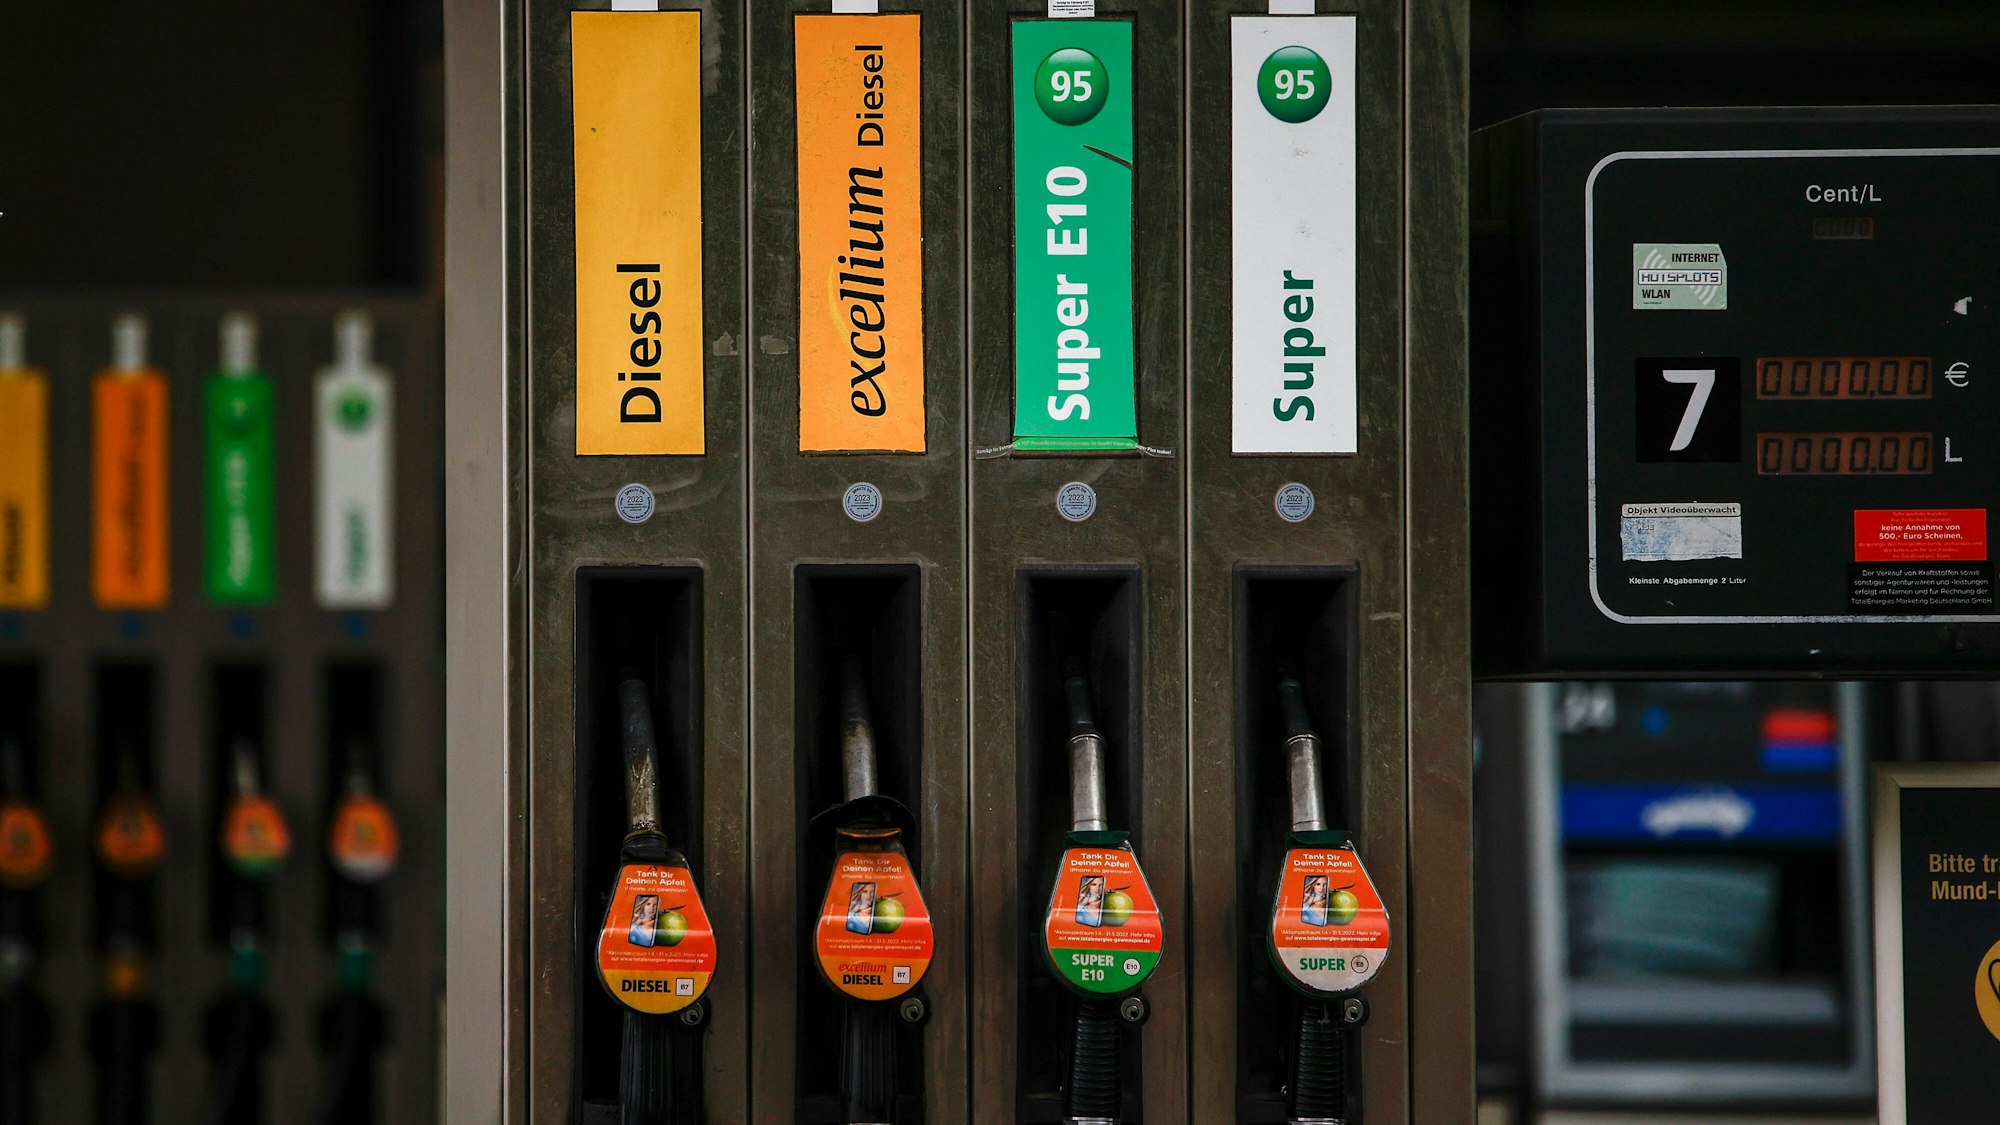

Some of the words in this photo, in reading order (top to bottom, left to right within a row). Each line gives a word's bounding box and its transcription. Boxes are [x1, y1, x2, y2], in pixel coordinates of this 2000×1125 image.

[856, 44, 884, 146] Diesel
[1050, 70, 1092, 102] 95
[1274, 70, 1315, 100] 95
[1806, 184, 1881, 204] Cent/L
[1046, 166, 1088, 256] E10
[1672, 254, 1719, 262] INTERNET
[838, 167, 887, 419] excellium
[1642, 289, 1670, 298] WLAN
[616, 263, 662, 423] Diesel
[1047, 274, 1101, 421] Super
[1273, 270, 1326, 422] Super
[1662, 370, 1716, 451] 7
[1945, 436, 1962, 462] L
[1628, 507, 1658, 515] Objekt
[1660, 506, 1736, 514] Videoüberwacht
[1663, 577, 1718, 585] Abgabemenge
[1929, 853, 1976, 873] Bitte
[1982, 854, 2000, 873] tr
[839, 962, 887, 973] excellium
[1072, 954, 1114, 967] SUPER
[1300, 958, 1345, 970] SUPER
[843, 974, 883, 985] DIESEL
[1082, 969, 1104, 981] E10
[622, 980, 671, 992] DIESEL
